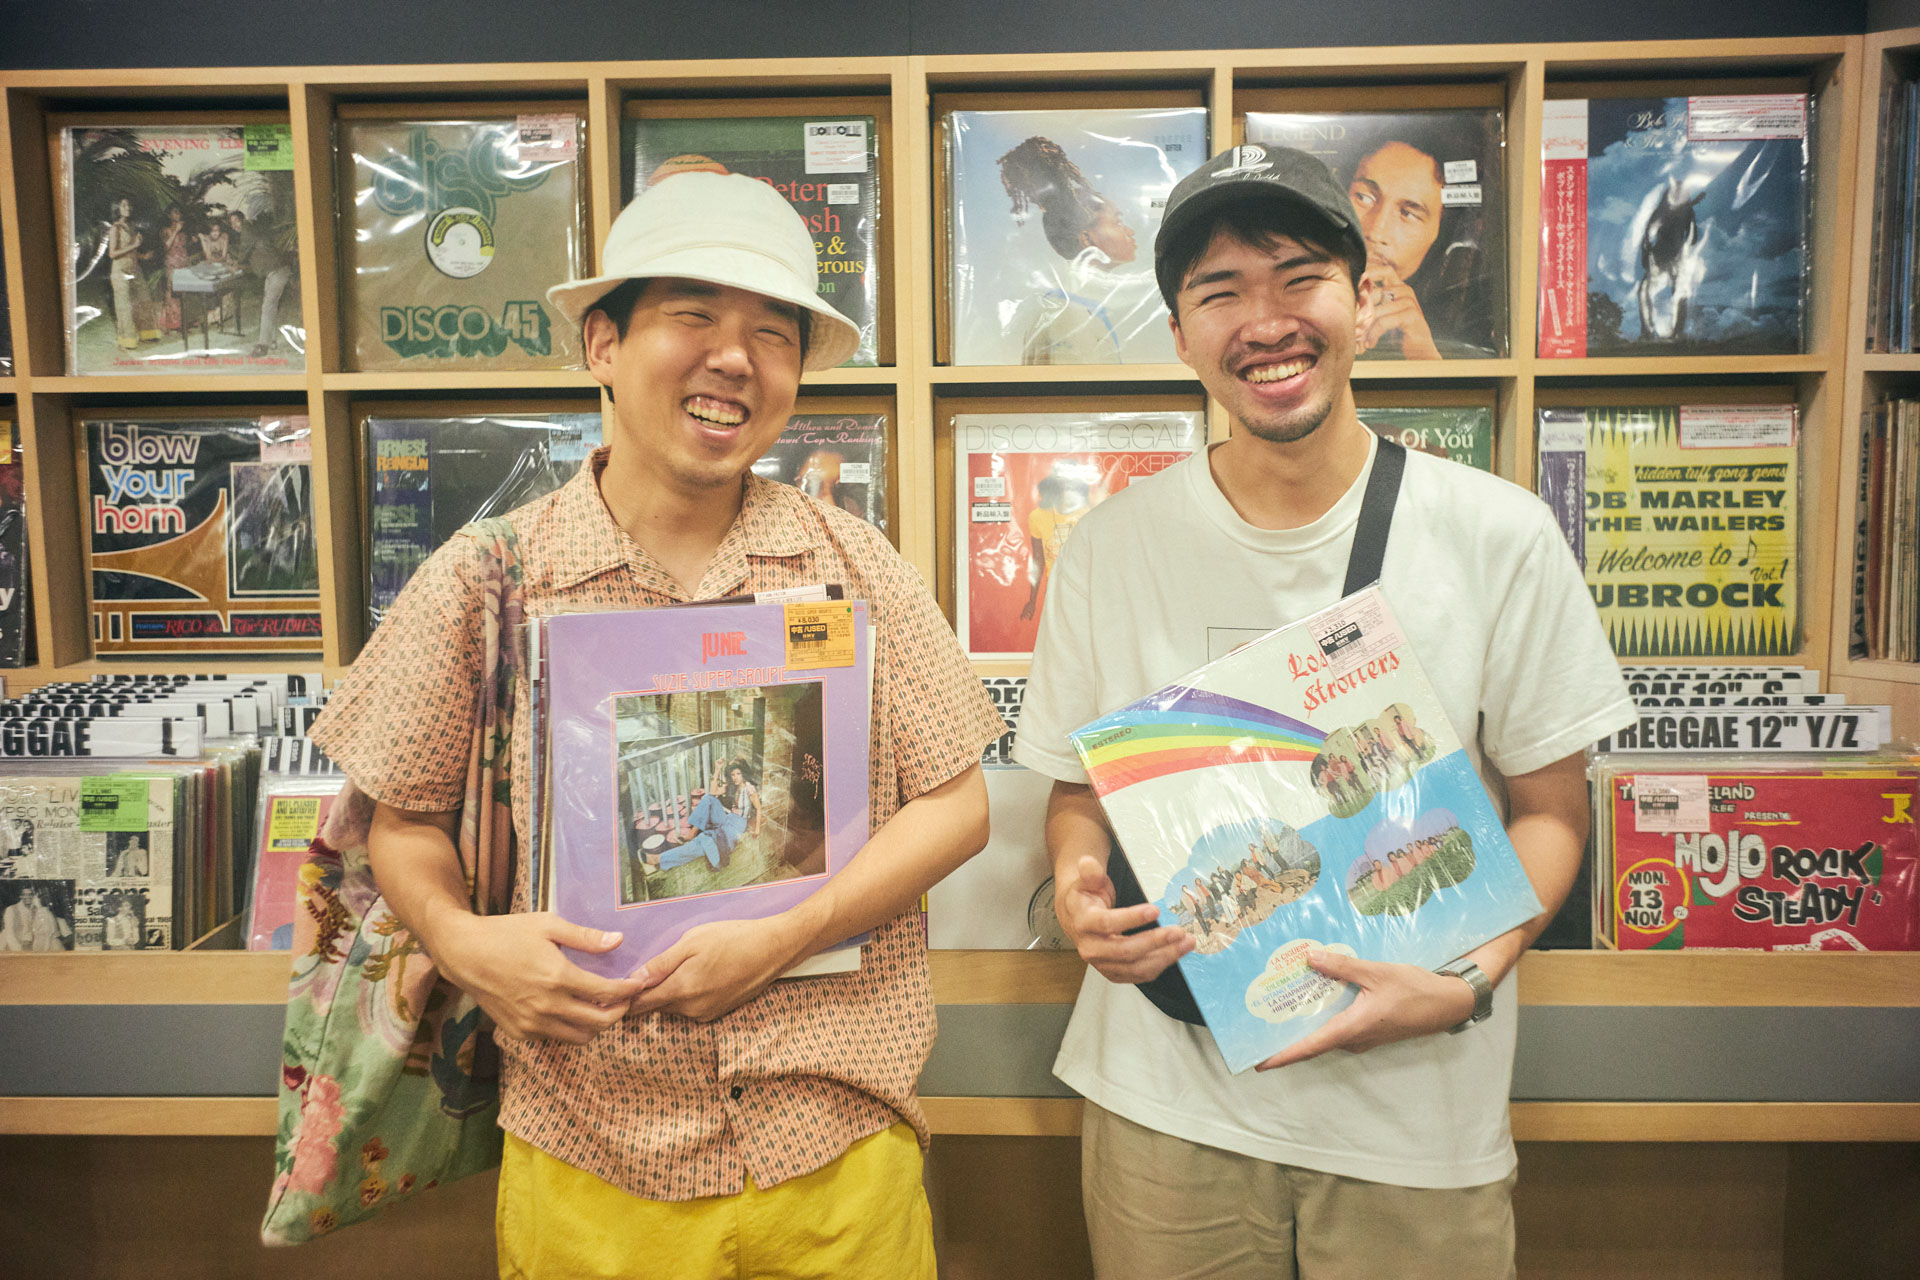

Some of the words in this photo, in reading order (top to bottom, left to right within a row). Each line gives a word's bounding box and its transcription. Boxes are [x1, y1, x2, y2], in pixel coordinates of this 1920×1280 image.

[142, 137, 210, 151] EVENING
[1257, 124, 1347, 141] LEGEND
[754, 176, 828, 202] eter
[827, 236, 847, 255] &
[381, 305, 494, 345] DISCO
[100, 422, 200, 465] blow
[965, 423, 1058, 451] DISCO
[1069, 422, 1193, 450] REGGAE
[1400, 427, 1429, 449] Of
[1433, 427, 1475, 449] You
[99, 464, 195, 505] your
[1635, 465, 1682, 482] hidden
[1714, 466, 1749, 482] gong
[1752, 465, 1787, 480] gems
[1640, 490, 1787, 509] MARLEY
[94, 494, 186, 534] horn
[1586, 516, 1642, 532] THE
[1652, 515, 1786, 532] WAILERS
[1597, 545, 1704, 575] Welcome
[1709, 542, 1733, 567] to
[701, 631, 747, 665] JUNIE
[1091, 727, 1133, 751] ESTEREO
[1617, 716, 1739, 749] REGGAE
[1746, 715, 1798, 749] 12"
[1805, 715, 1859, 749] Y/Z
[1675, 830, 1766, 897] MOJO
[1771, 840, 1874, 886] ROCK
[1628, 871, 1669, 885] MON.
[1630, 889, 1663, 909] 13
[1733, 882, 1864, 926] STEADY
[1624, 910, 1665, 926] NOV.
